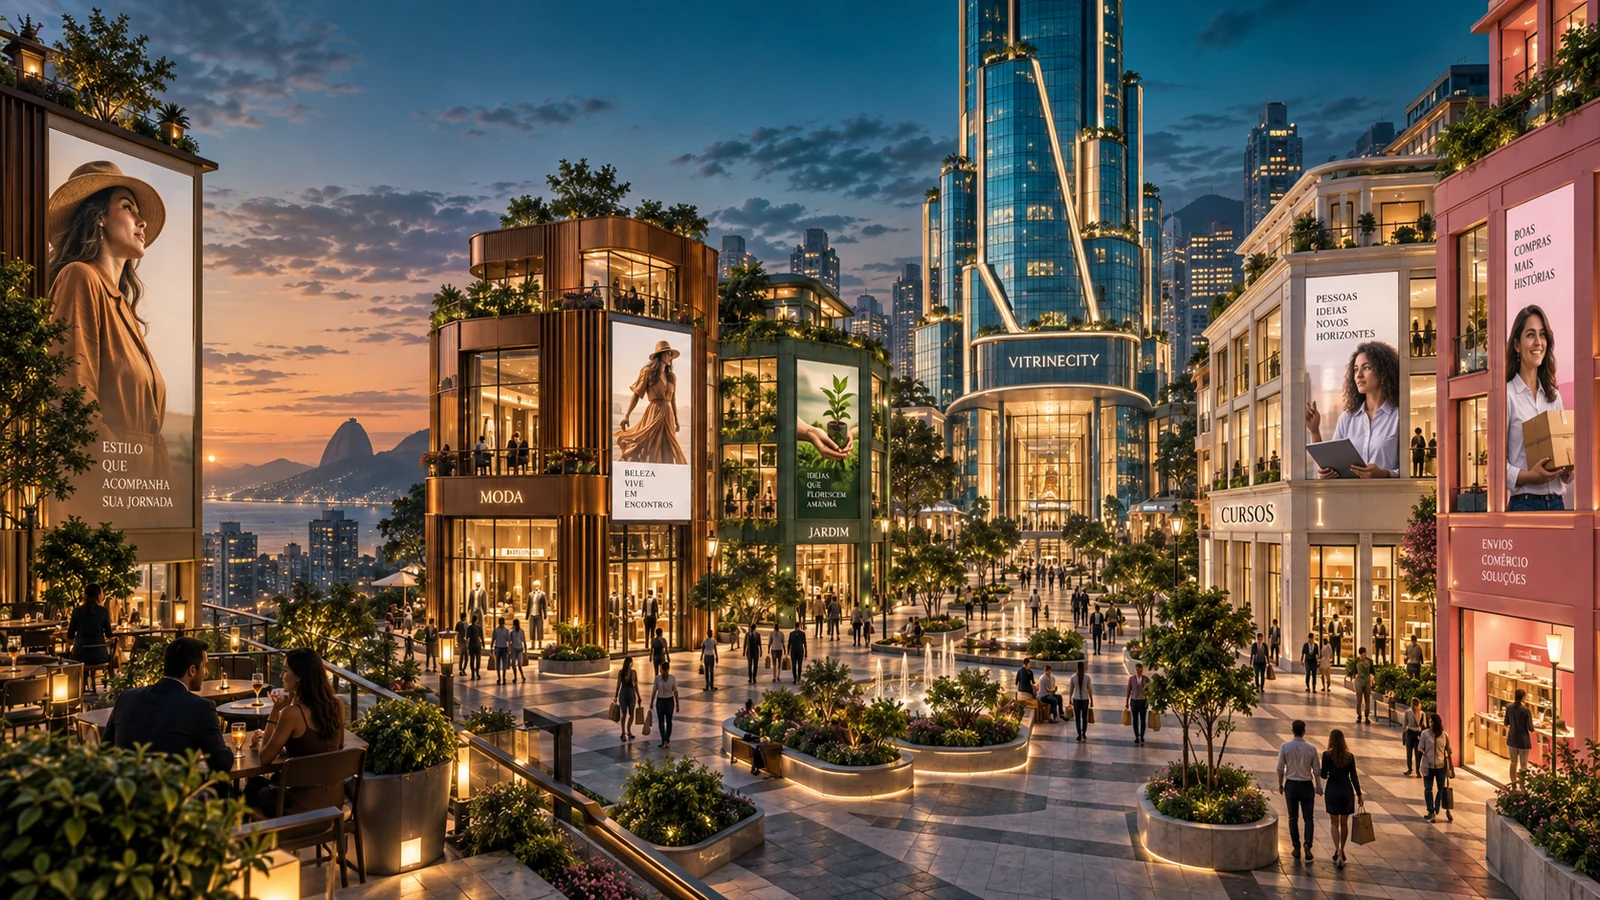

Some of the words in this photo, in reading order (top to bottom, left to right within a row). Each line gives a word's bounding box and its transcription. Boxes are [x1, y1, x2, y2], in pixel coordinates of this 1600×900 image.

[1514, 223, 1536, 241] BOAS
[1513, 234, 1552, 257] COMPRAS
[1514, 258, 1534, 274] MAIS
[1514, 268, 1556, 290] HISTÓRIAS
[1316, 292, 1358, 303] PESSOAS
[1316, 306, 1348, 316] IDEIAS
[1316, 318, 1349, 329] NOVOS
[1316, 329, 1376, 341] HORIZONTES
[1008, 354, 1100, 369] VITRINECITY
[102, 441, 143, 455] ESTILO
[102, 459, 128, 473] QUE
[624, 469, 656, 478] BELEZA
[102, 478, 170, 491] ACOMPANHA
[624, 479, 645, 488] VIVE
[806, 481, 821, 489] QUE
[480, 490, 524, 504] MODA
[624, 490, 638, 498] EM
[102, 496, 124, 508] SUA
[126, 496, 174, 509] JORNADA
[624, 501, 674, 509] ENCONTROS
[1221, 504, 1275, 524] CURSOS
[808, 526, 849, 539] JARDIM
[1481, 538, 1514, 551] ENVIOS
[1481, 553, 1529, 568] COMÉRCIO
